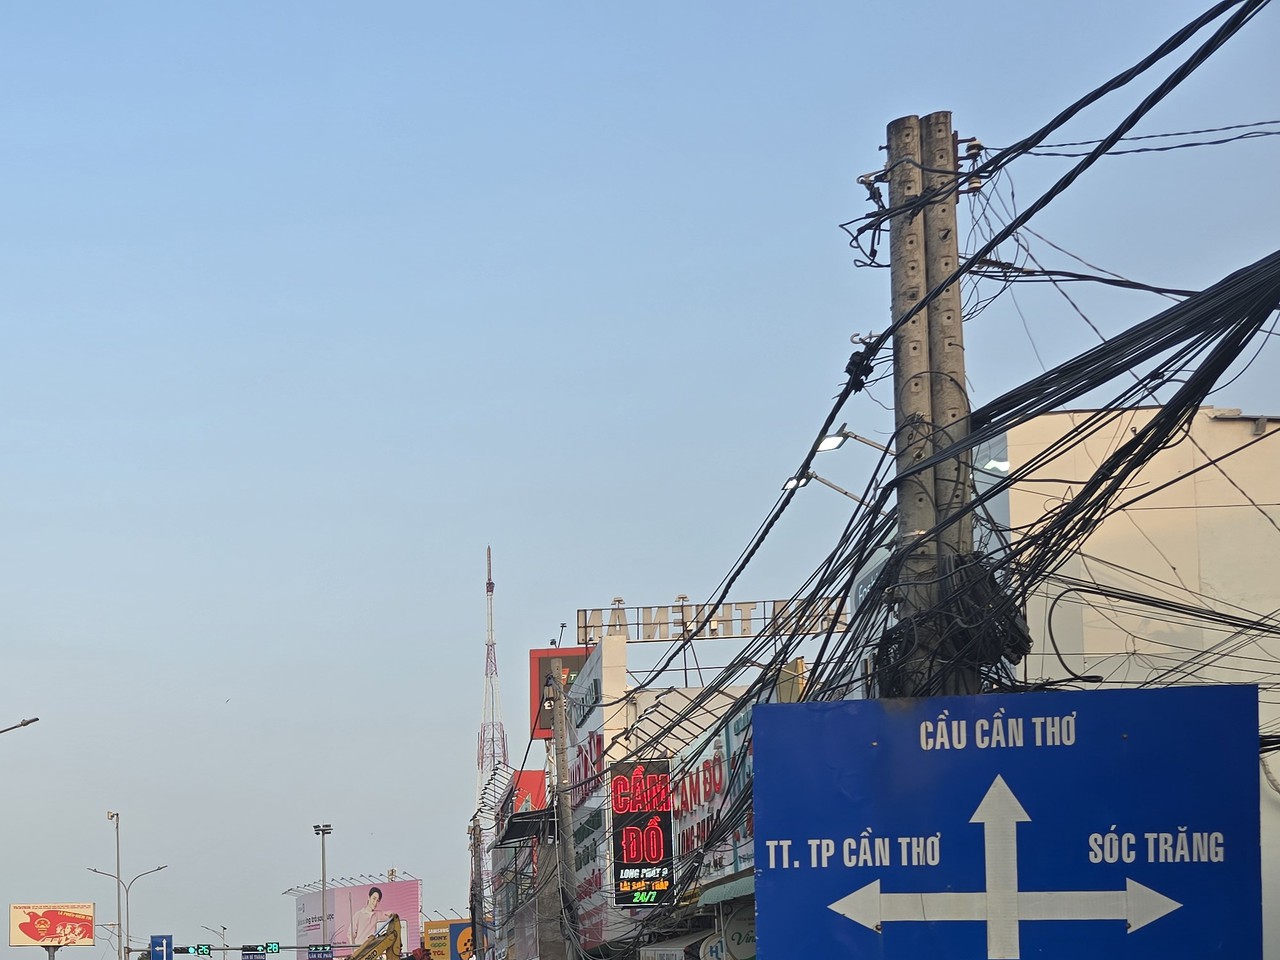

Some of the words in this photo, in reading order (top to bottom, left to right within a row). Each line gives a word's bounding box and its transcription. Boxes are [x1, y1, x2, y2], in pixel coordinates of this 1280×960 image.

[920, 709, 966, 750] CẦU
[975, 707, 1024, 749] CẦN
[1032, 711, 1077, 746] THƠ
[611, 765, 670, 813] CẦM
[622, 815, 664, 864] ĐỒ
[766, 840, 799, 869] TT.
[808, 839, 835, 867] TP
[842, 826, 890, 867] CẦN
[898, 831, 942, 866] THƠ
[1088, 825, 1136, 864] SÓC
[1145, 826, 1225, 863] TRĂNG
[632, 891, 657, 902] 24/7
[198, 945, 209, 955] 26
[267, 943, 278, 953] 28
